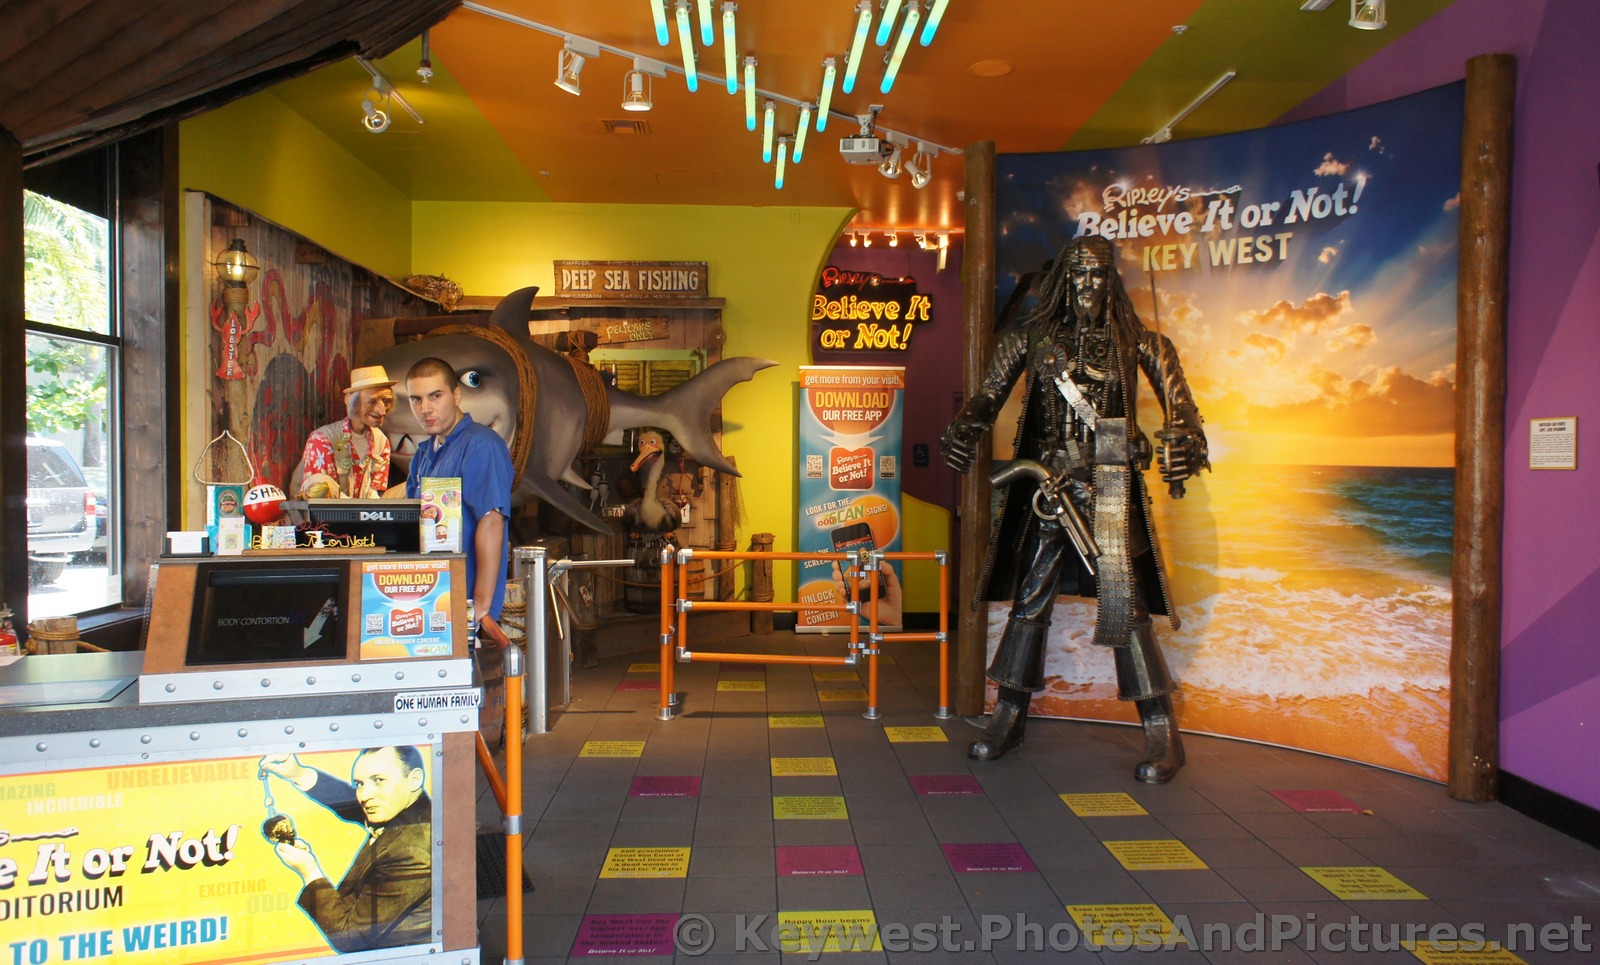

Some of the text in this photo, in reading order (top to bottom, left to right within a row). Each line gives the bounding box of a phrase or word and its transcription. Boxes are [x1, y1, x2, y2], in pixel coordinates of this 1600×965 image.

[1102, 183, 1193, 213] Ripley's
[1072, 174, 1367, 241] Believe It or Not!
[1143, 232, 1293, 272] KEY WEST
[561, 268, 700, 292] DEEP SEA FISHING
[812, 294, 932, 321] Believe It
[606, 321, 652, 339] PELICANS
[629, 330, 655, 341] ONLY
[821, 323, 913, 350] or Not!
[226, 318, 237, 377] LOBSTER
[804, 374, 900, 387] get more from your visit!
[815, 391, 890, 409] DOWNLOAD
[822, 409, 883, 421] OUR FREE APP
[832, 458, 873, 476] Believe It
[838, 467, 868, 483] or Not!
[805, 497, 851, 516] LOOK FOR THE
[866, 503, 889, 516] SIGNS!
[359, 511, 394, 521] DELL
[366, 564, 378, 572] get
[379, 563, 397, 571] more
[397, 562, 414, 570] from
[415, 563, 430, 571] your
[378, 573, 435, 586] DOWNLOAD
[384, 584, 430, 594] OUR FREE APP
[801, 589, 835, 605] UNLOCK
[217, 616, 290, 627] BODY CONTORTION
[395, 698, 415, 711] ONE
[417, 696, 448, 709] HUMAN
[450, 694, 480, 707] FAMILY
[106, 762, 250, 790] UNBELIEVABLE
[27, 793, 123, 816] INCREDIBLE
[27, 843, 72, 887] It
[82, 845, 135, 880] or
[141, 824, 238, 875] Not!
[198, 879, 267, 899] EXCITING
[246, 892, 290, 915] ODD
[9, 916, 228, 965] TO THE WEIRD!
